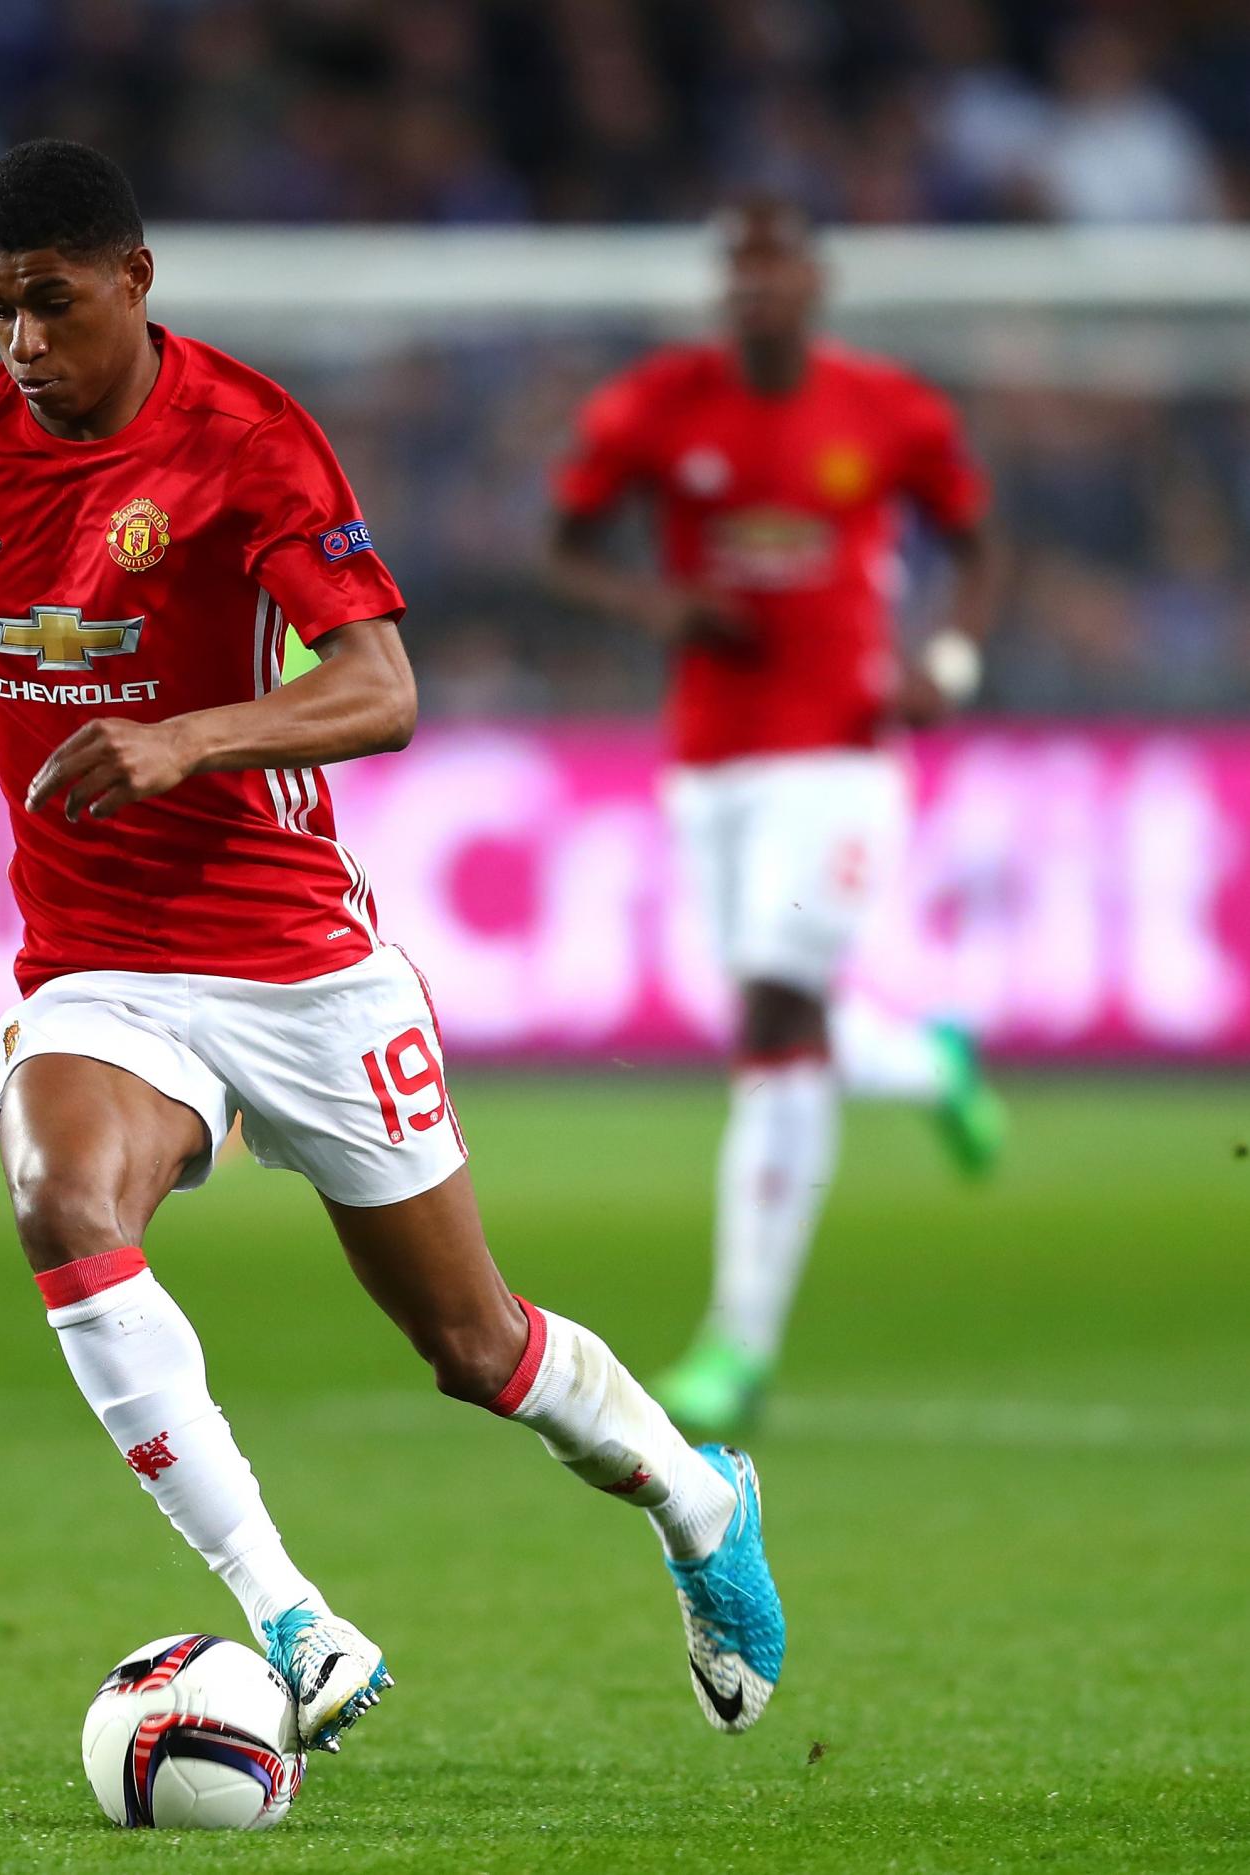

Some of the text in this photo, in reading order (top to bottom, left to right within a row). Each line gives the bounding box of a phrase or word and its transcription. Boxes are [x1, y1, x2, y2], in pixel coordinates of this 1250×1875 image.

[115, 503, 164, 528] MANCHESTER
[117, 553, 155, 567] UNITED
[361, 1027, 445, 1145] 19
